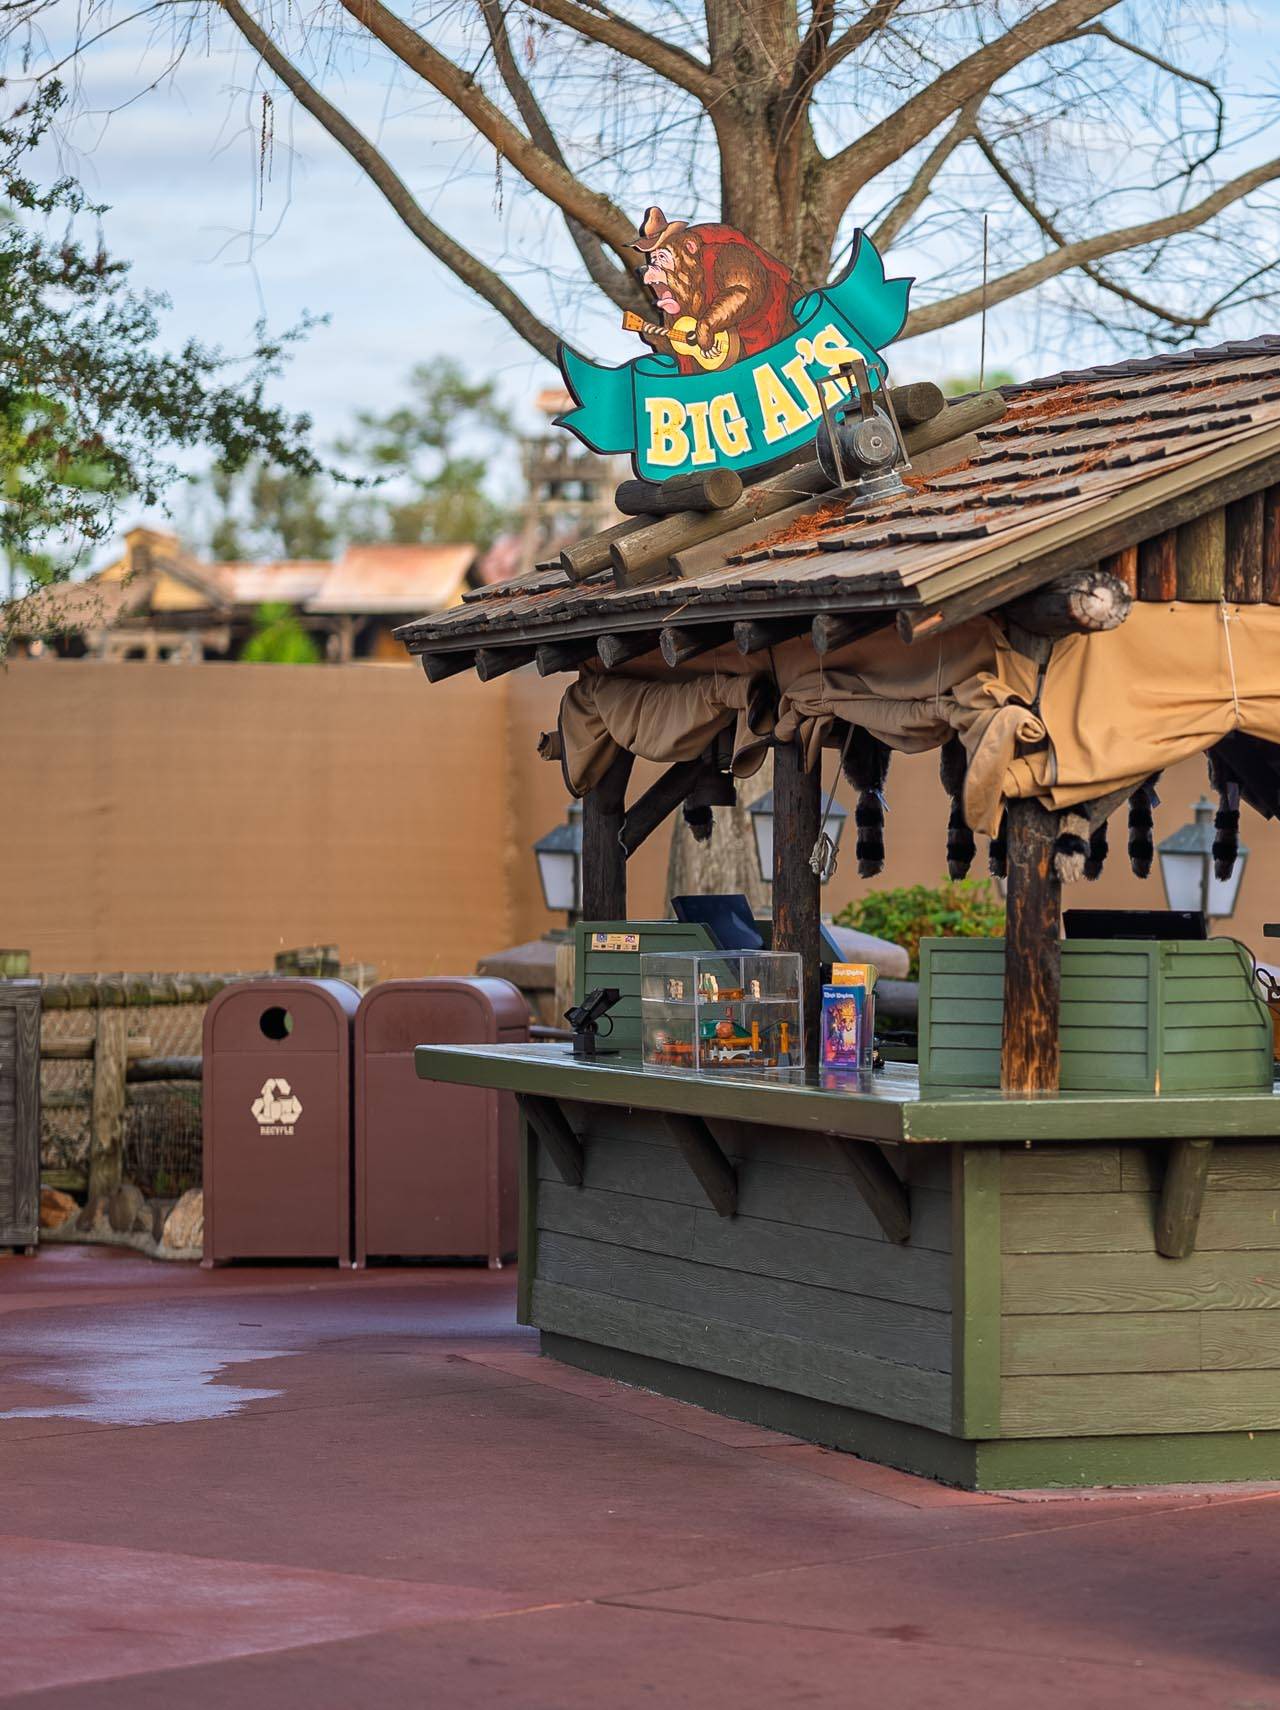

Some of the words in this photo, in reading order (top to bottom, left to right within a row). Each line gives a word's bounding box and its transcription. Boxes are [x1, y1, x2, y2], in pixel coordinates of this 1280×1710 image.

[645, 391, 752, 467] BIG
[752, 323, 867, 445] AL'S
[260, 1125, 294, 1136] RECYCLE
